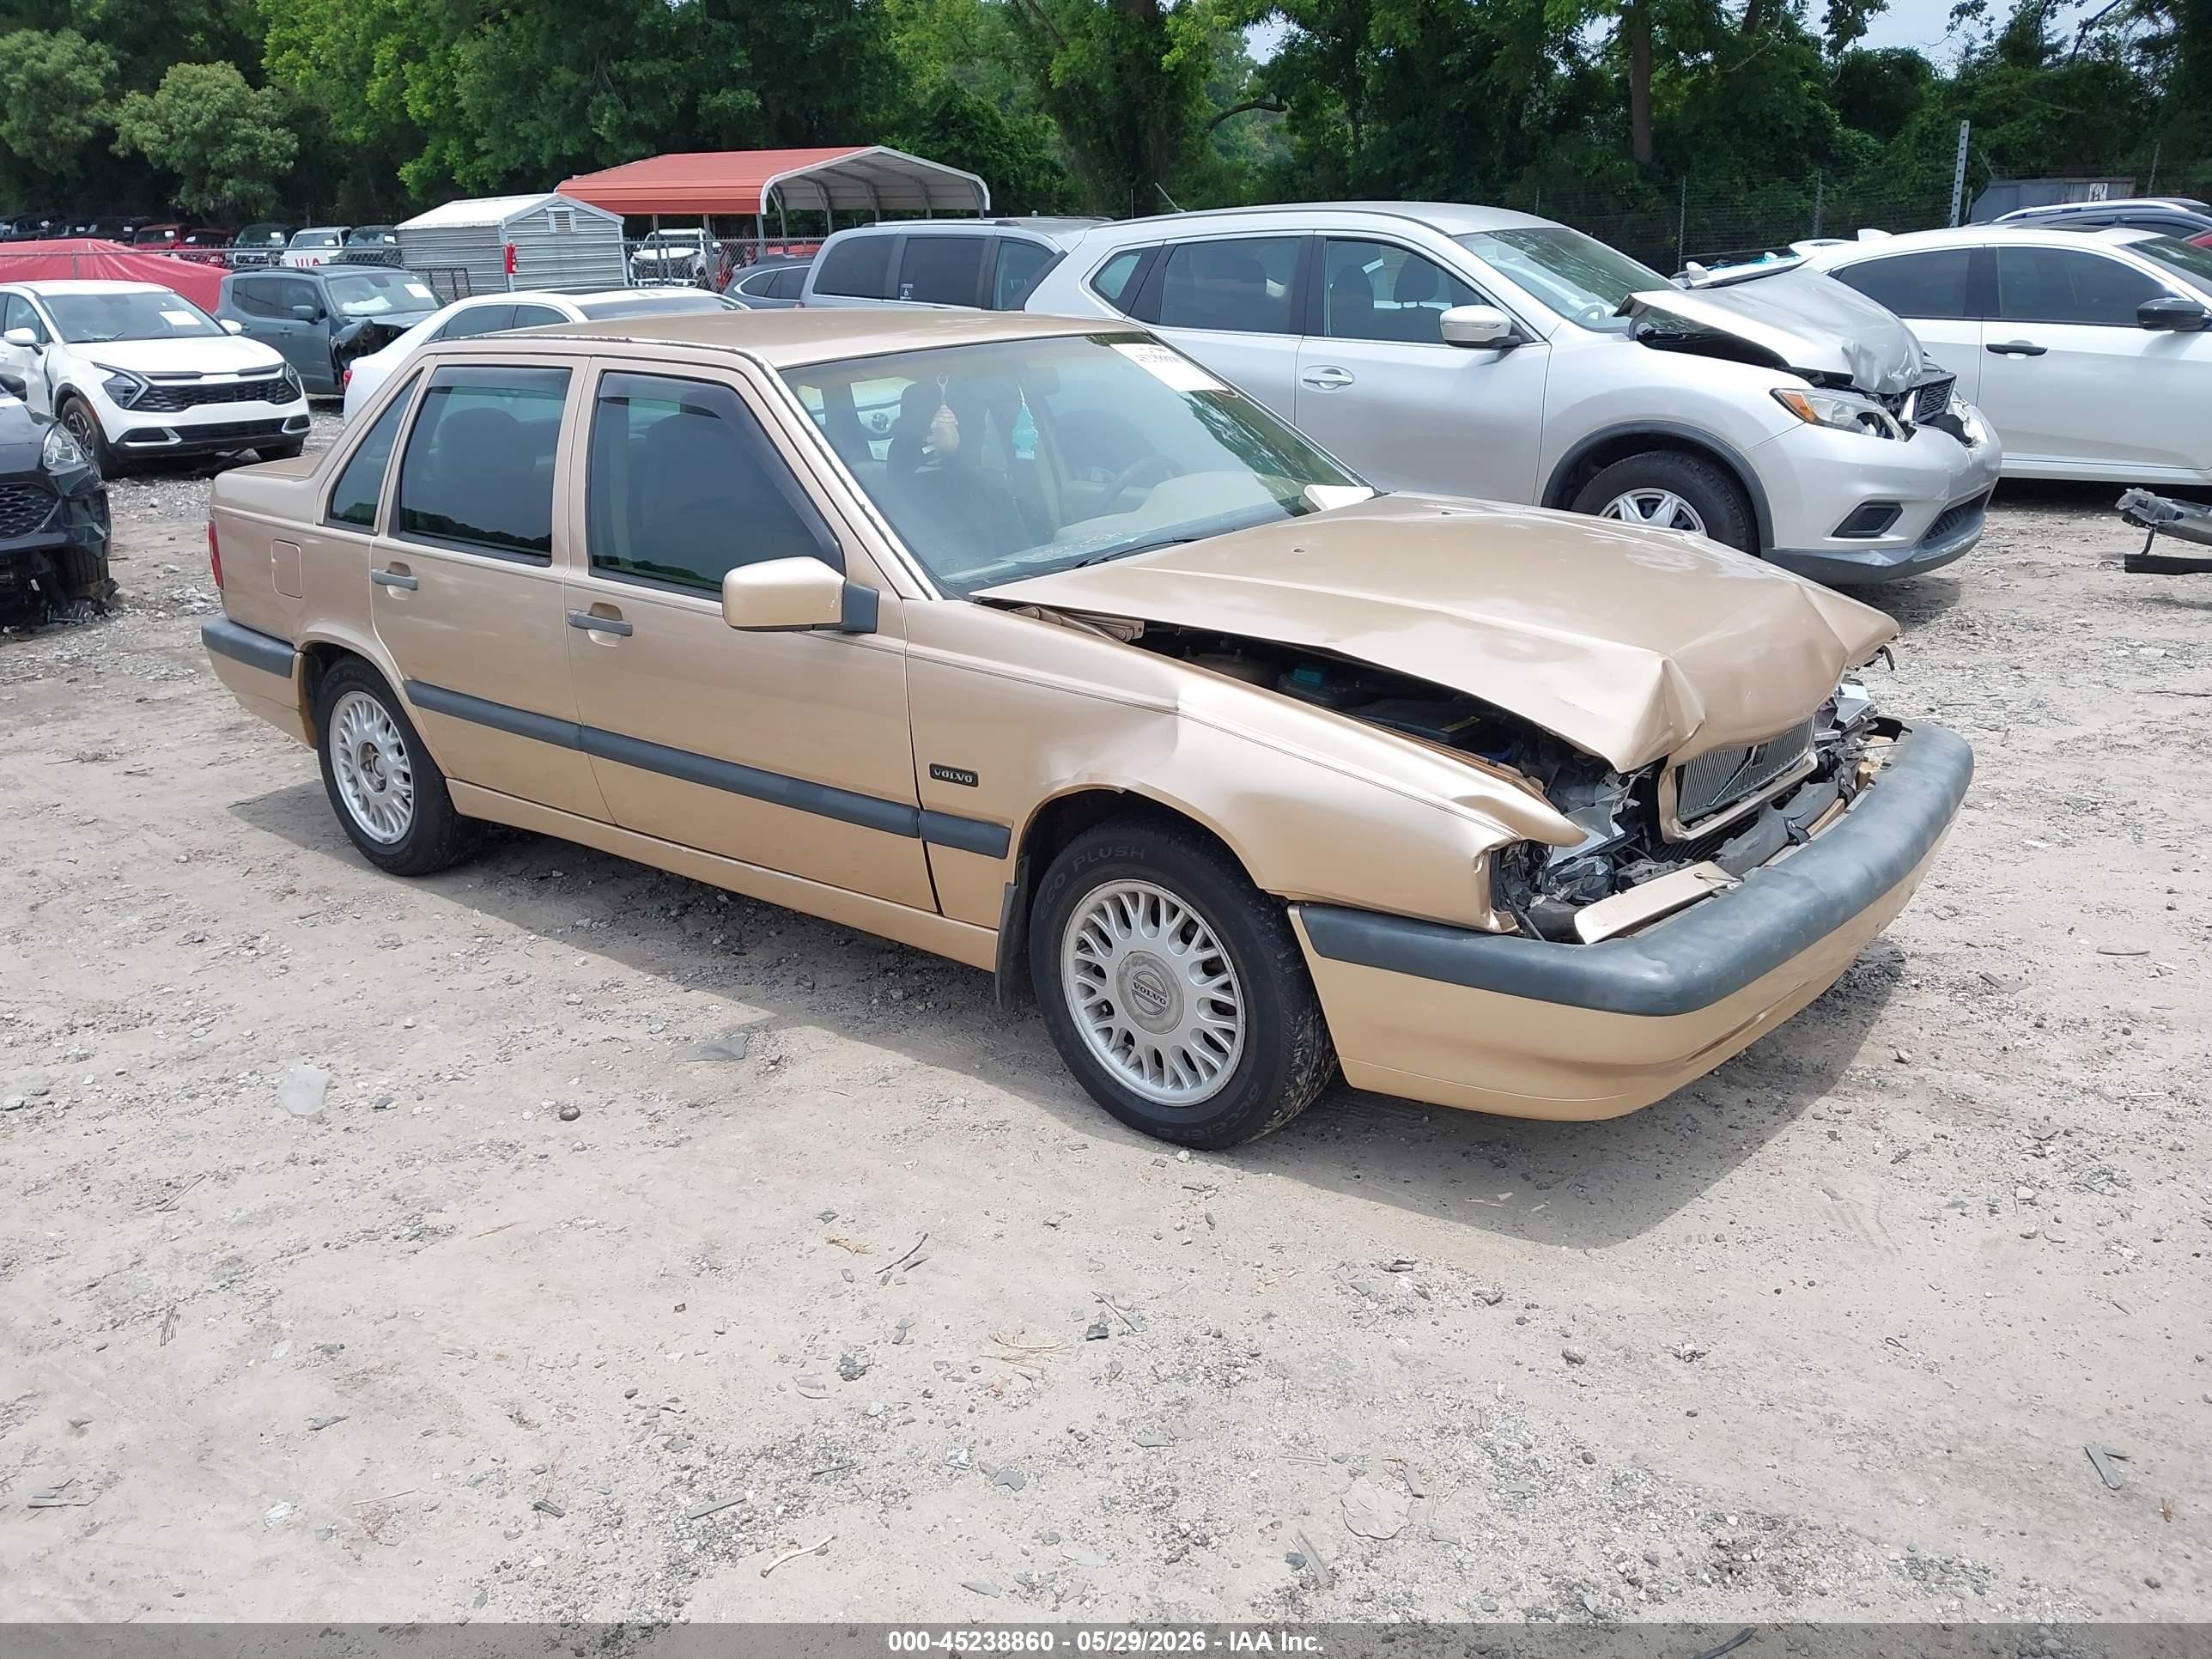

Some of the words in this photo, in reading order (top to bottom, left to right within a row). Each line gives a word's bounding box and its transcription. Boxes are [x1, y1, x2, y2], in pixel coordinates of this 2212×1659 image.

[933, 769, 973, 783] VOLVO
[1073, 845, 1146, 872] PLUSH
[1133, 981, 1167, 1006] VOLVO
